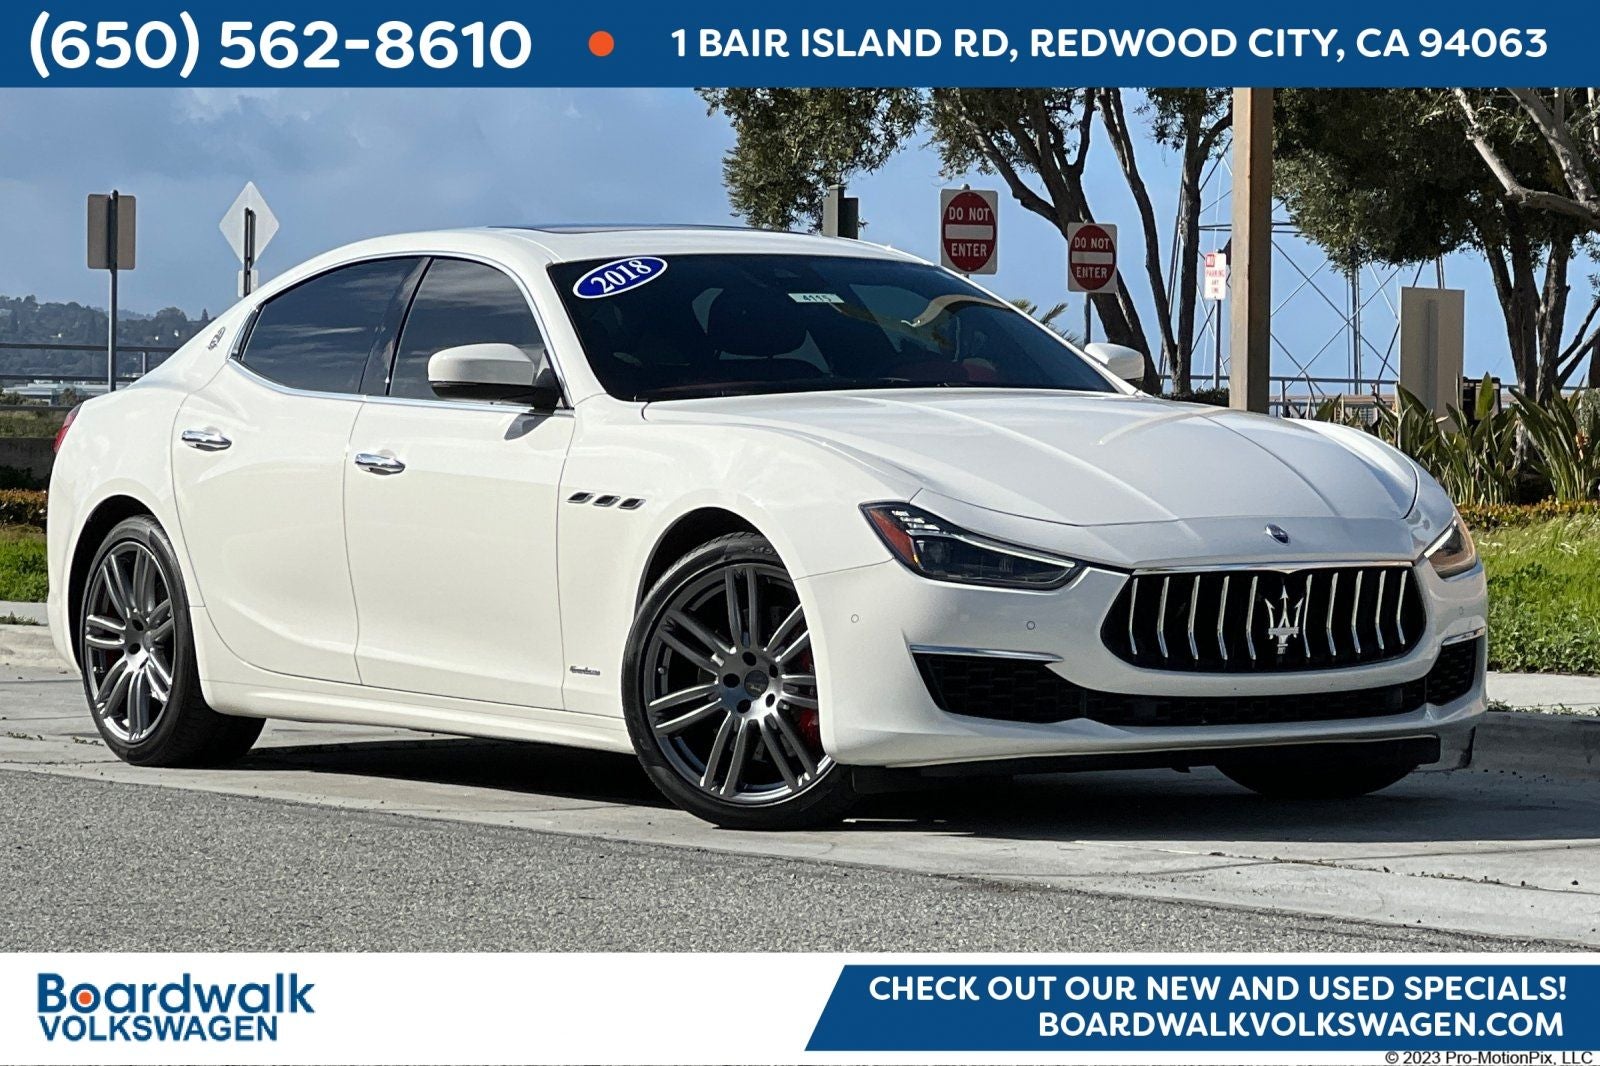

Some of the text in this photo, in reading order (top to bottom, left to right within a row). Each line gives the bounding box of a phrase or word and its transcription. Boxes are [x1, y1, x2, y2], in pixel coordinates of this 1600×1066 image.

[949, 207, 990, 221] DO NOT
[951, 242, 987, 257] ENTER
[1074, 236, 1110, 250] DO NOT
[590, 260, 652, 293] 2018
[1076, 266, 1108, 278] ENTER
